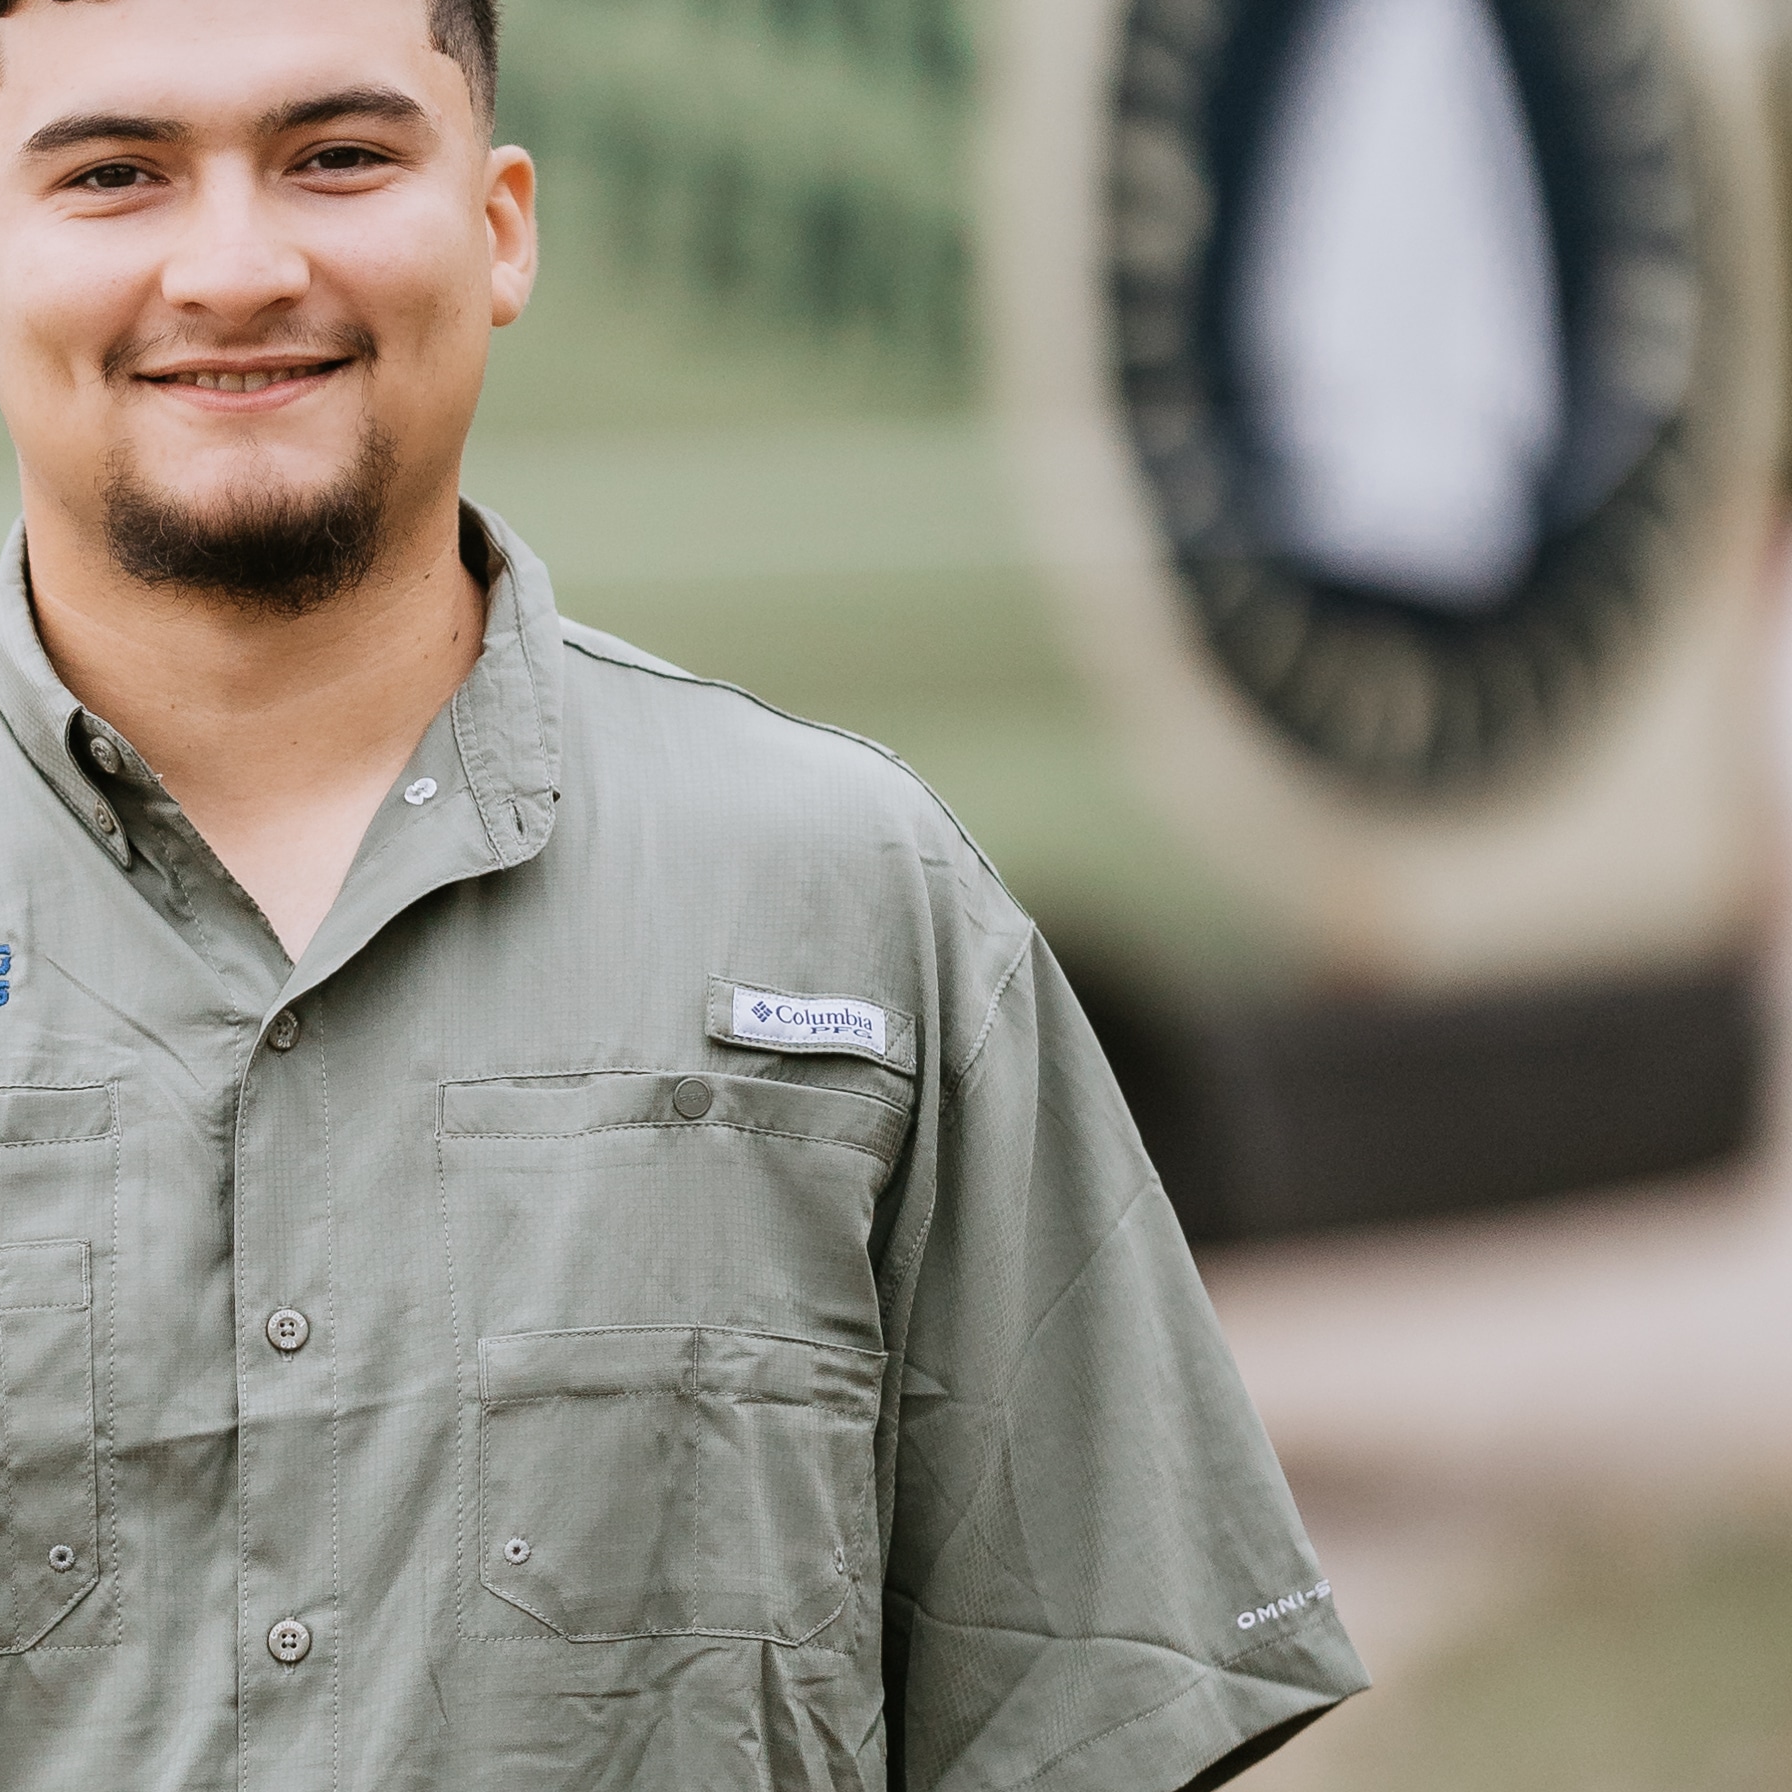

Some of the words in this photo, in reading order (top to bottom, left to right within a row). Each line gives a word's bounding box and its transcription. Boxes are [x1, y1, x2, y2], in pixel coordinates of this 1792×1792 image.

[775, 1004, 873, 1031] Columbia
[810, 1025, 873, 1040] PFG
[1236, 1578, 1332, 1630] OMNI-S
